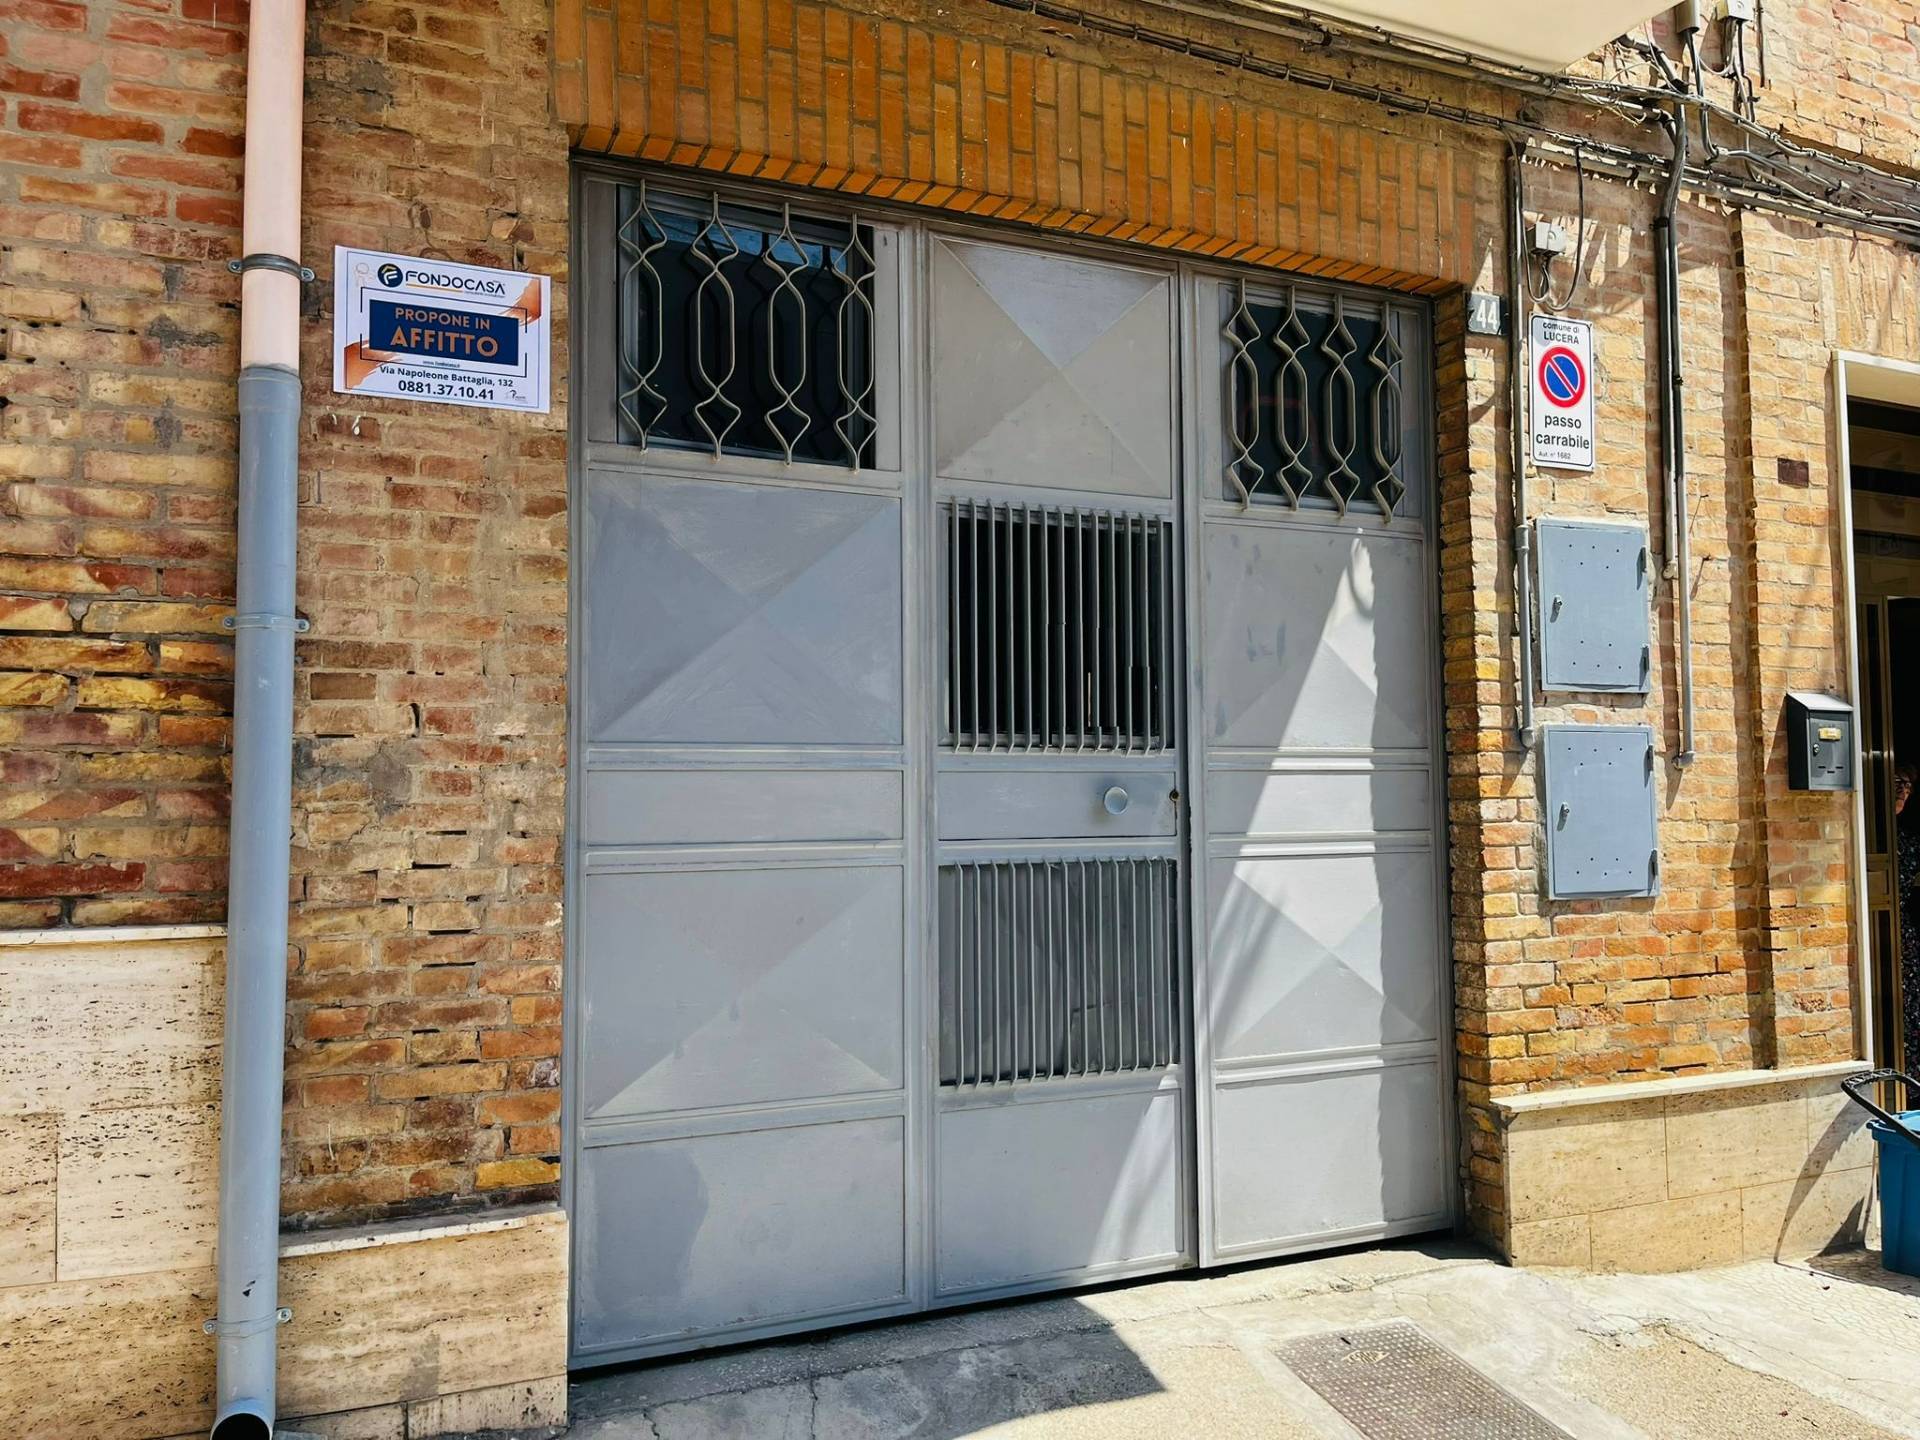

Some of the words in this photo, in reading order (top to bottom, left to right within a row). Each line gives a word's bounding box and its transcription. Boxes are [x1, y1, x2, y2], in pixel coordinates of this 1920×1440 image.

[405, 270, 506, 295] FONDOCASA
[395, 307, 470, 328] PROPONE
[475, 318, 490, 330] IN
[1477, 299, 1498, 330] 44
[1542, 321, 1571, 333] comune
[1572, 325, 1580, 334] di
[1543, 331, 1580, 345] LUCERA
[390, 325, 498, 357] AFFITTO
[380, 366, 395, 375] Via
[397, 368, 449, 381] Napoleone
[451, 373, 495, 386] Battaglia,
[498, 378, 513, 387] 132
[398, 379, 494, 400] 0881.37.10.41
[1544, 414, 1582, 429] passo
[1536, 433, 1590, 450] carrabile
